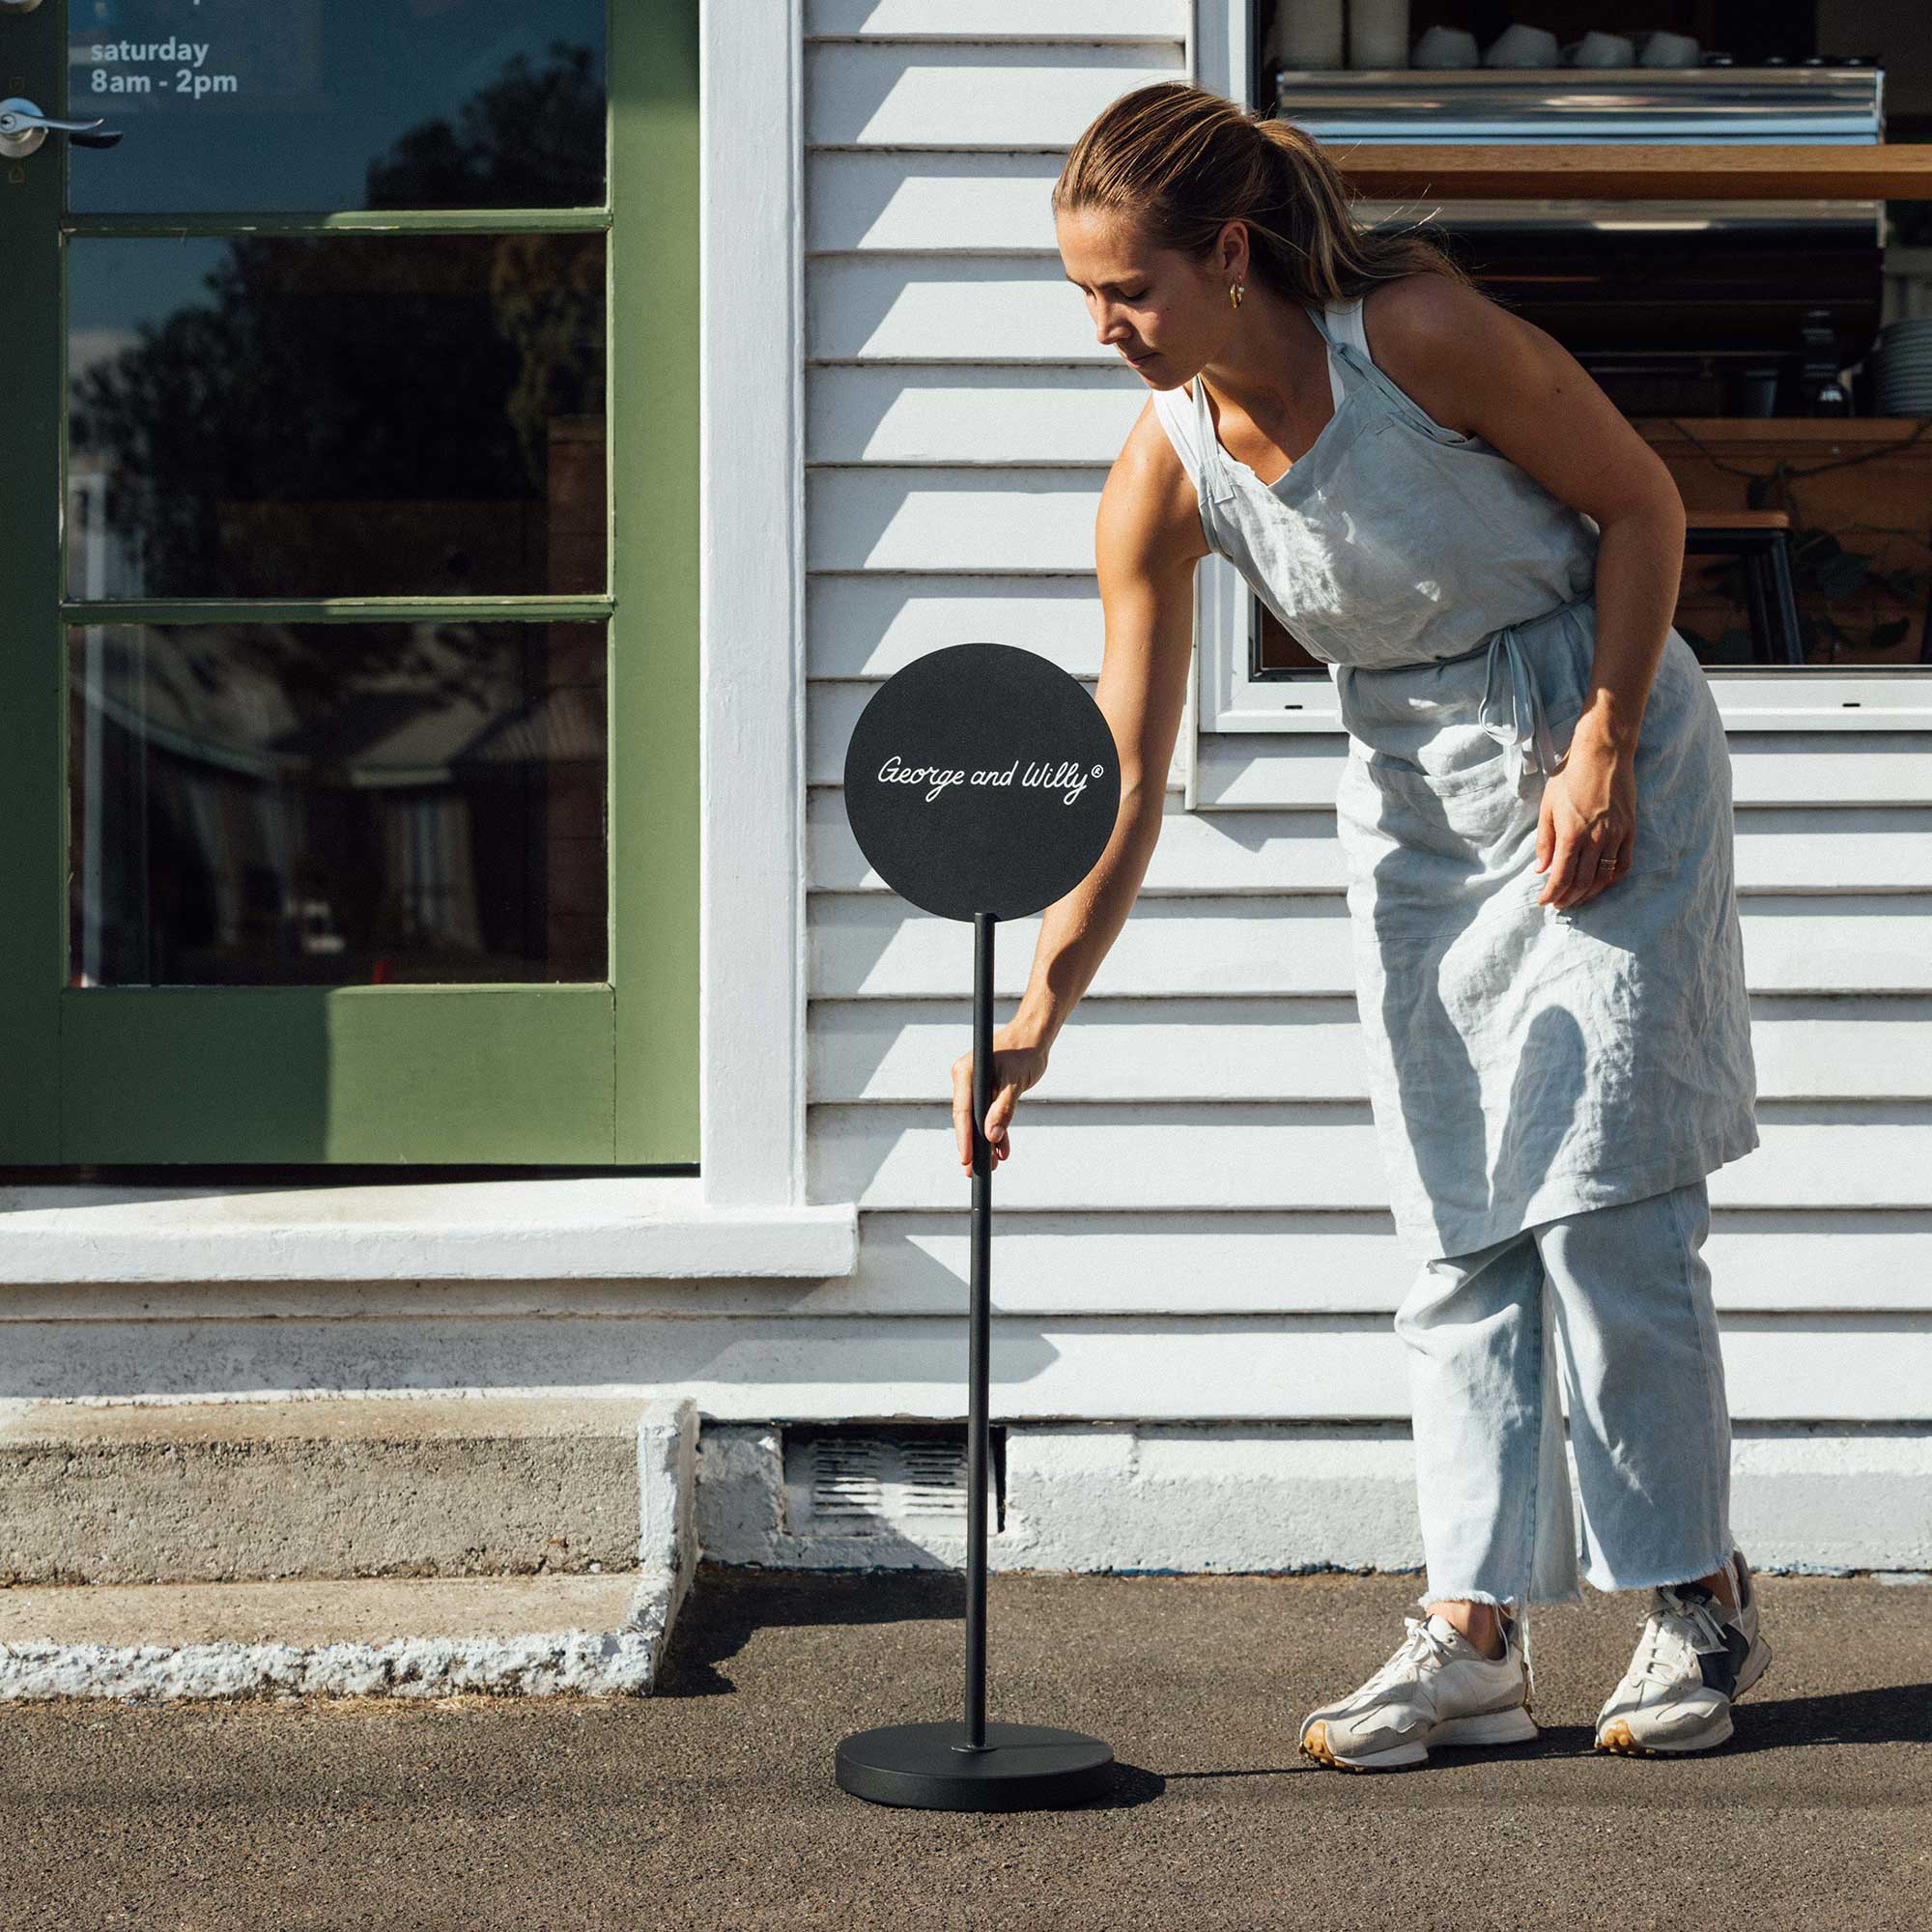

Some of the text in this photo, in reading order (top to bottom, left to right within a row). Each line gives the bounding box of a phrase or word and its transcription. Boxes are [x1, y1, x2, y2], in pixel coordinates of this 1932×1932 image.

[91, 36, 209, 68] saturday
[91, 70, 151, 94] 8am
[176, 70, 238, 99] 2pm
[877, 755, 965, 803] George
[970, 759, 1019, 786] and
